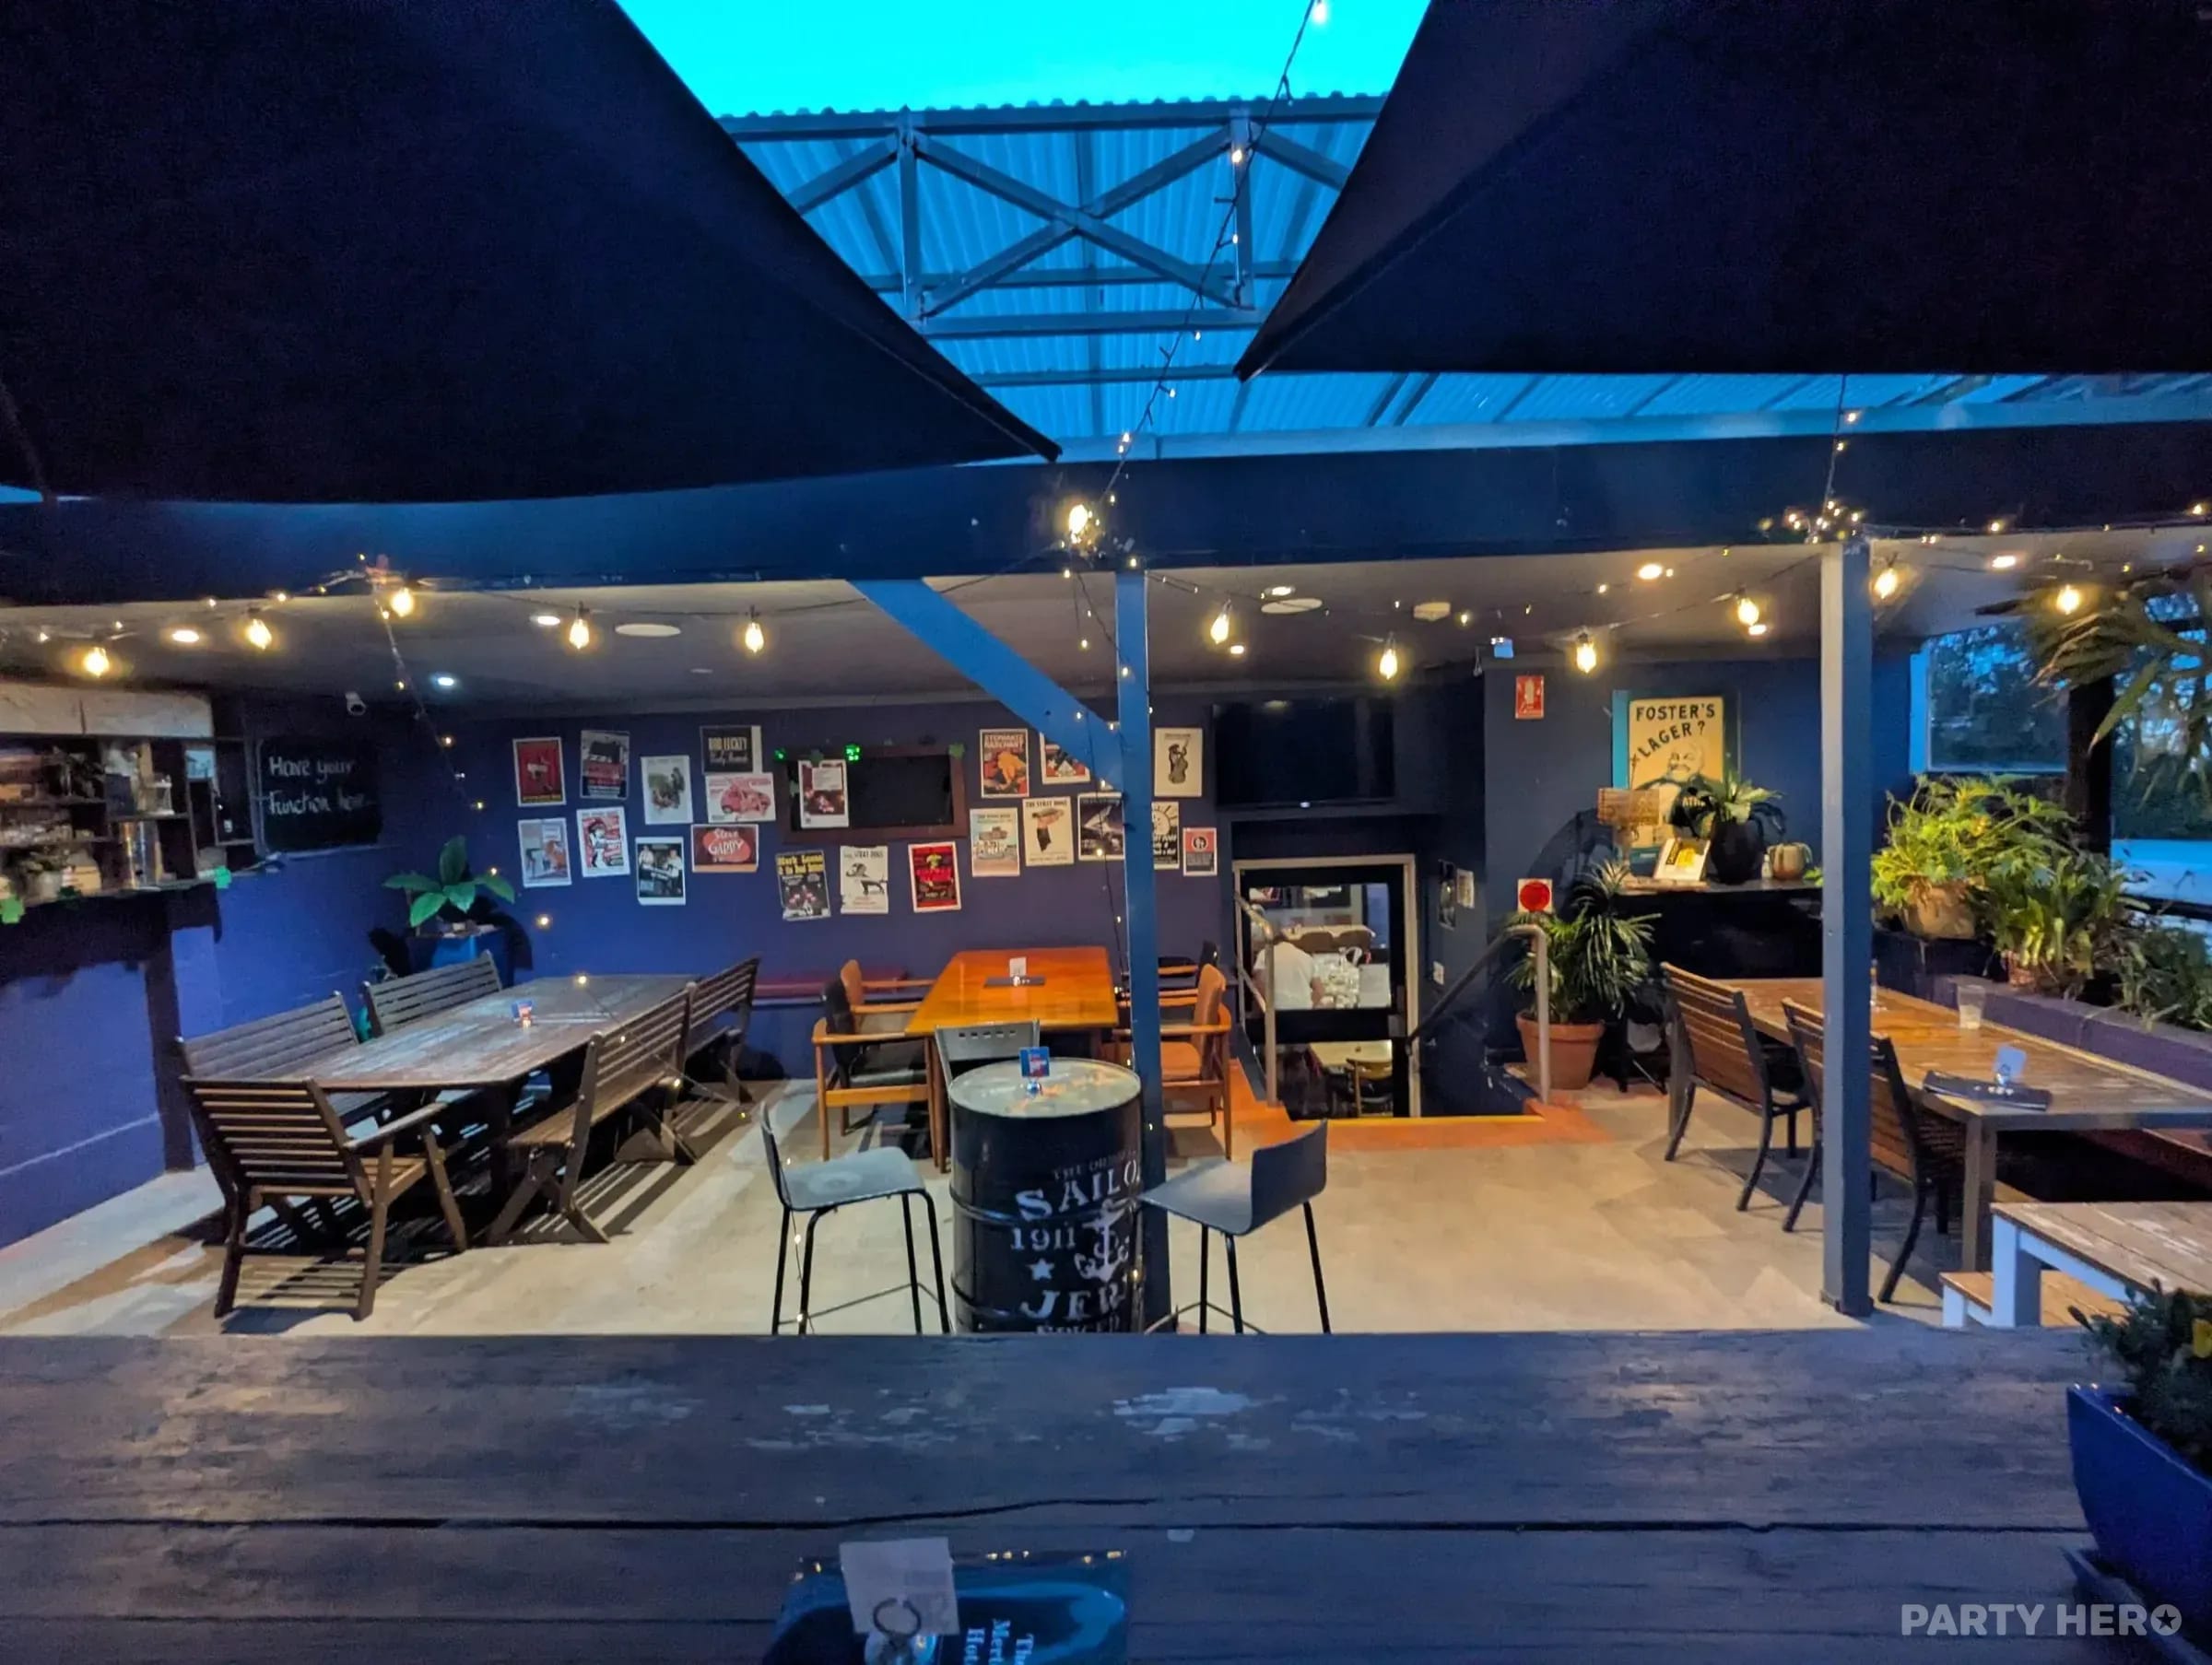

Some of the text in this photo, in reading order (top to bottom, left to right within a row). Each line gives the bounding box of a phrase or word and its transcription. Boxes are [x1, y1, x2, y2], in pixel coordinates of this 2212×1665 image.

[1635, 703, 1716, 721] FOSTER'S
[268, 756, 311, 777] Have
[963, 1627, 985, 1664] Hot
[988, 1618, 1011, 1664] Mert
